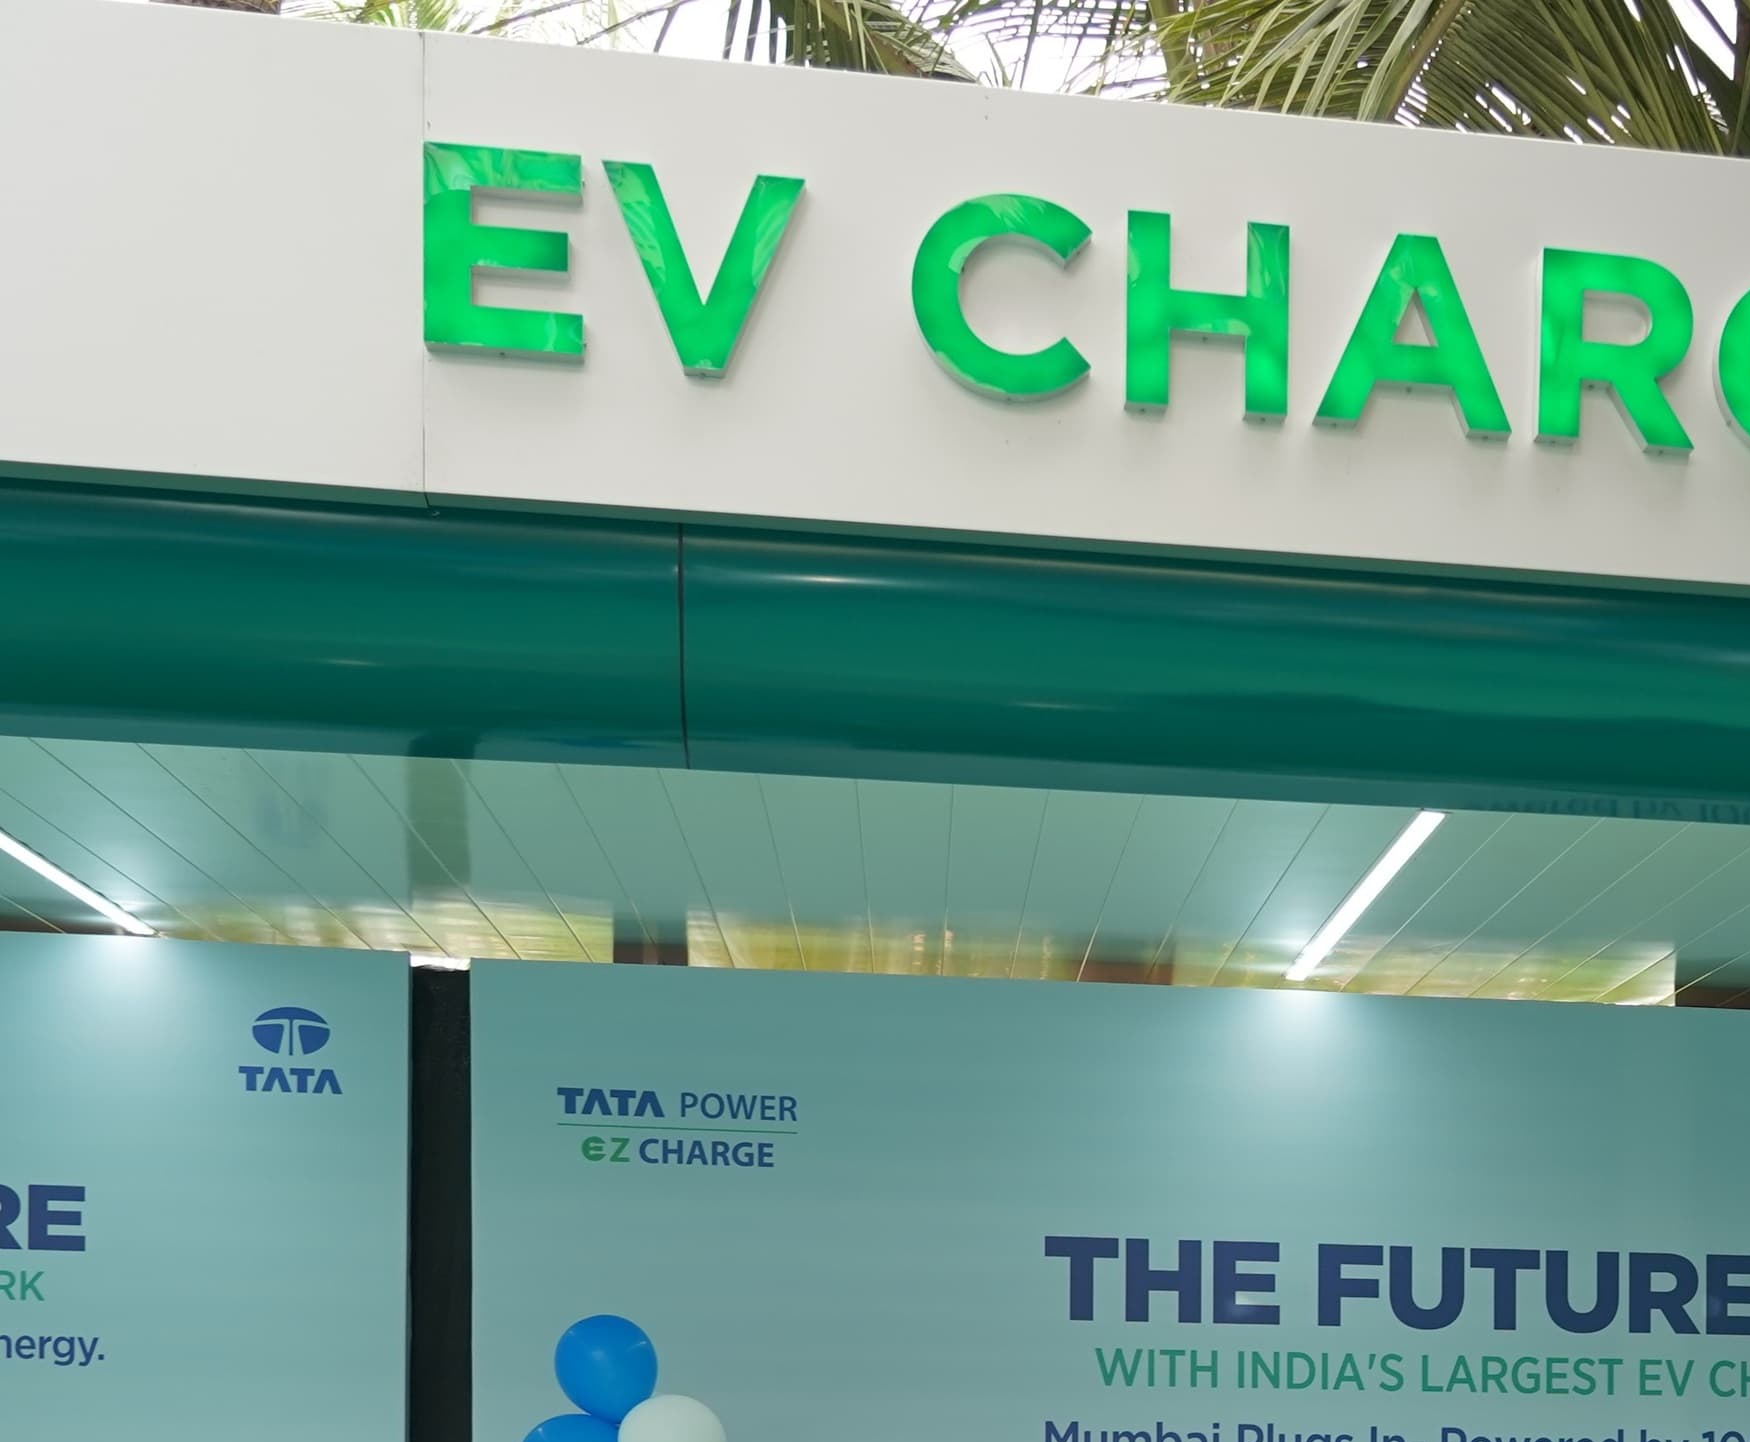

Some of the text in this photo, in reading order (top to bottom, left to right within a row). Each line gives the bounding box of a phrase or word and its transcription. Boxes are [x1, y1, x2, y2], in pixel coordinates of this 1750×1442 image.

[422, 140, 806, 378] EV
[239, 1065, 343, 1095] TATA
[557, 1086, 798, 1122] TATA POWER
[638, 1138, 775, 1167] CHARGE
[1044, 1235, 1281, 1326] THE
[1095, 1347, 1219, 1388] WITH
[1236, 1350, 1404, 1393] INDIA'S
[1420, 1354, 1624, 1396] LARGEST
[1639, 1359, 1695, 1398] EV
